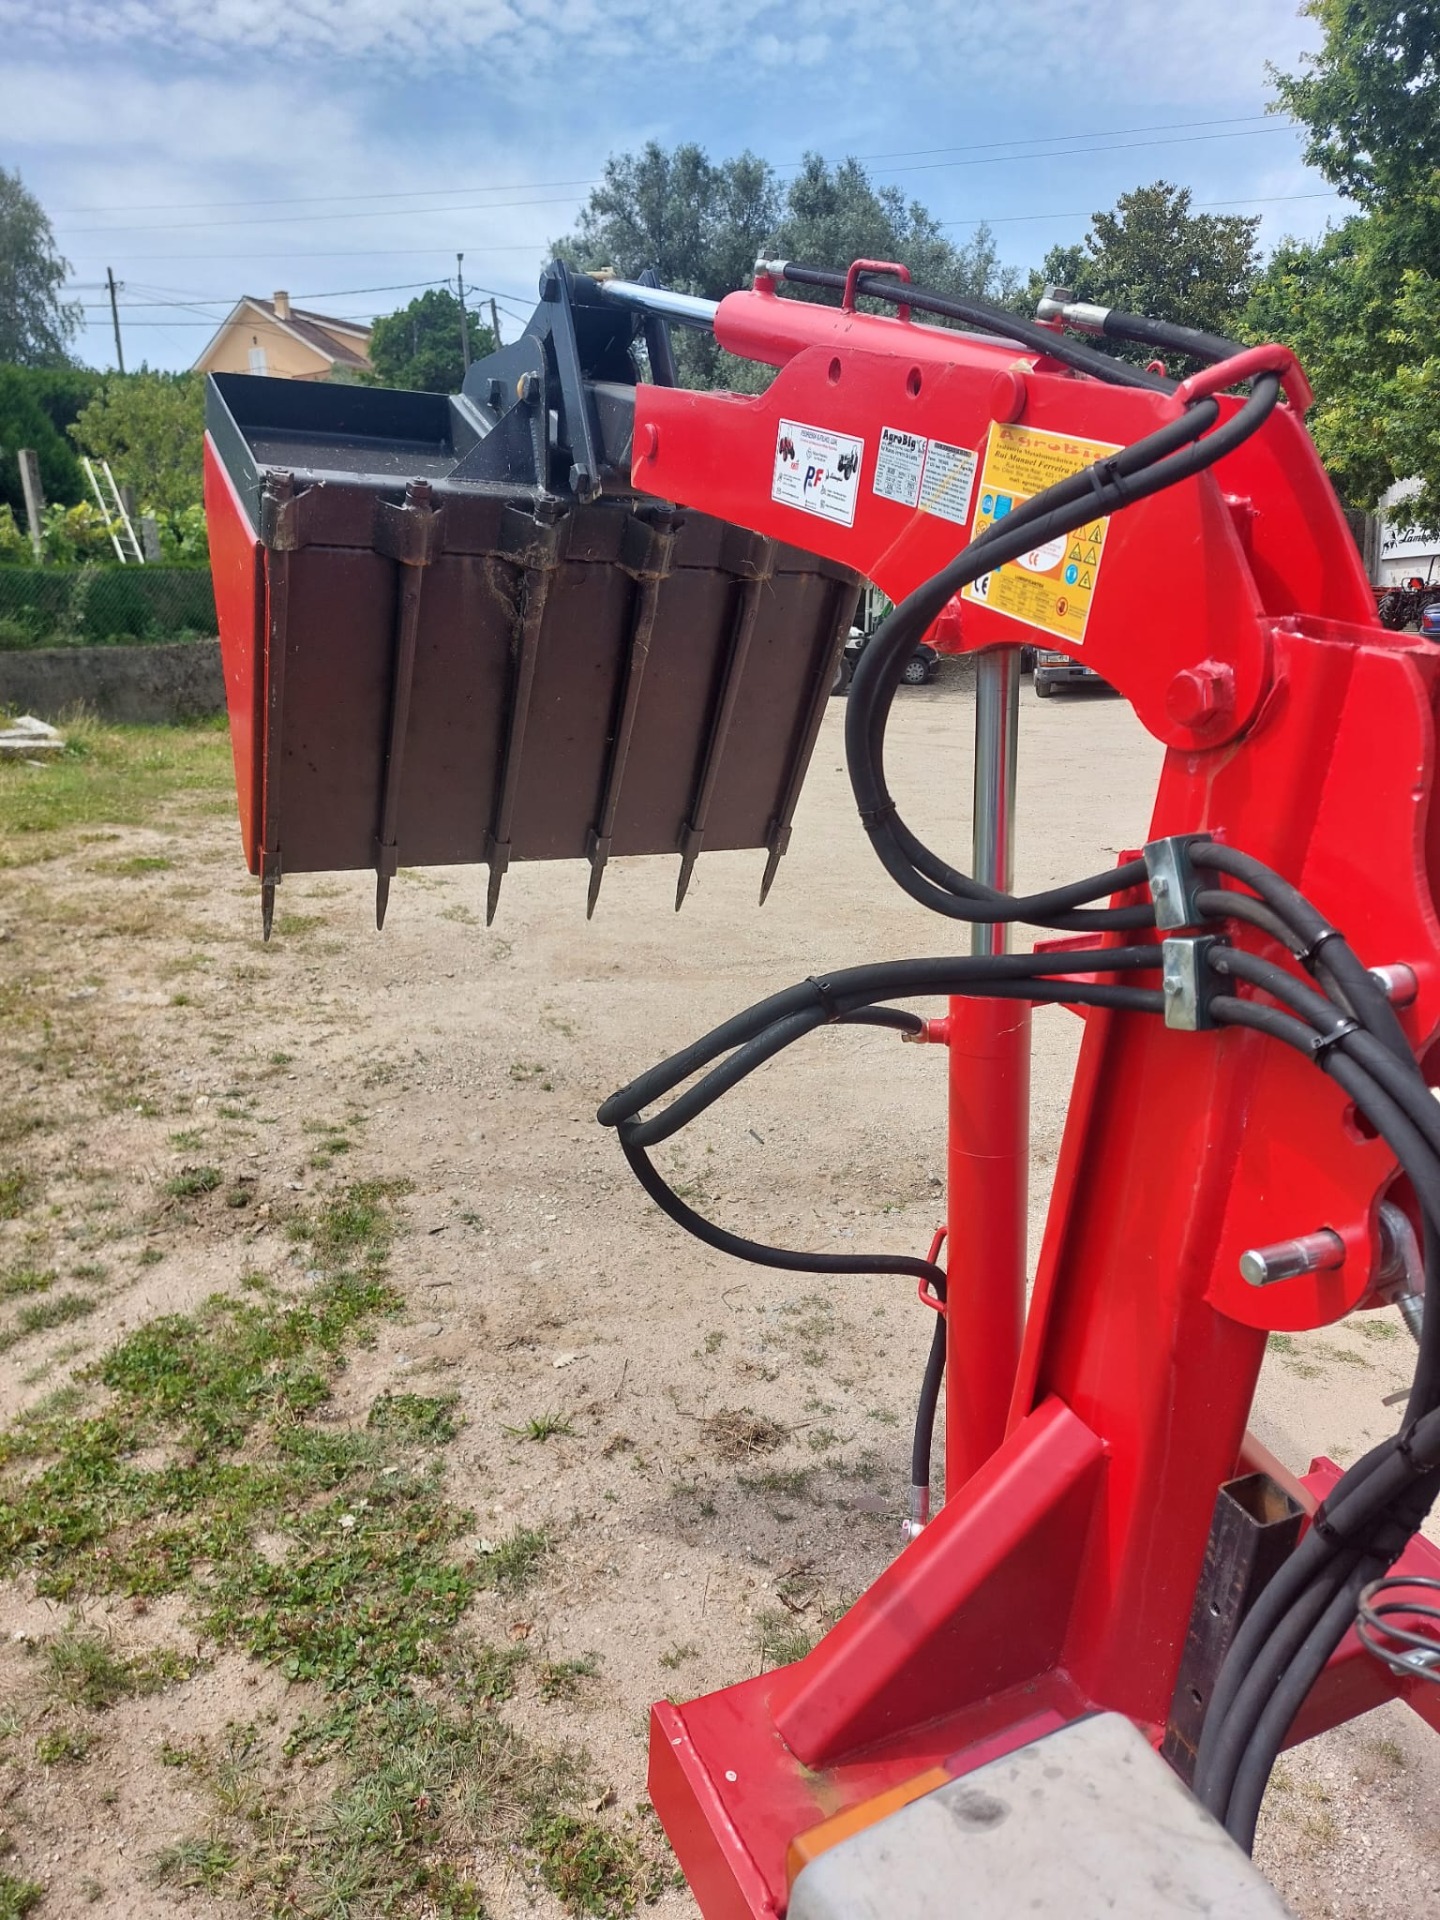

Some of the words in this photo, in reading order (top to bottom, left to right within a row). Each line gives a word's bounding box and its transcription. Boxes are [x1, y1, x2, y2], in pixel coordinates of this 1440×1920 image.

[1009, 455, 1036, 466] Manuel
[1038, 461, 1070, 474] Ferreira
[1398, 528, 1440, 544] Lamborg
